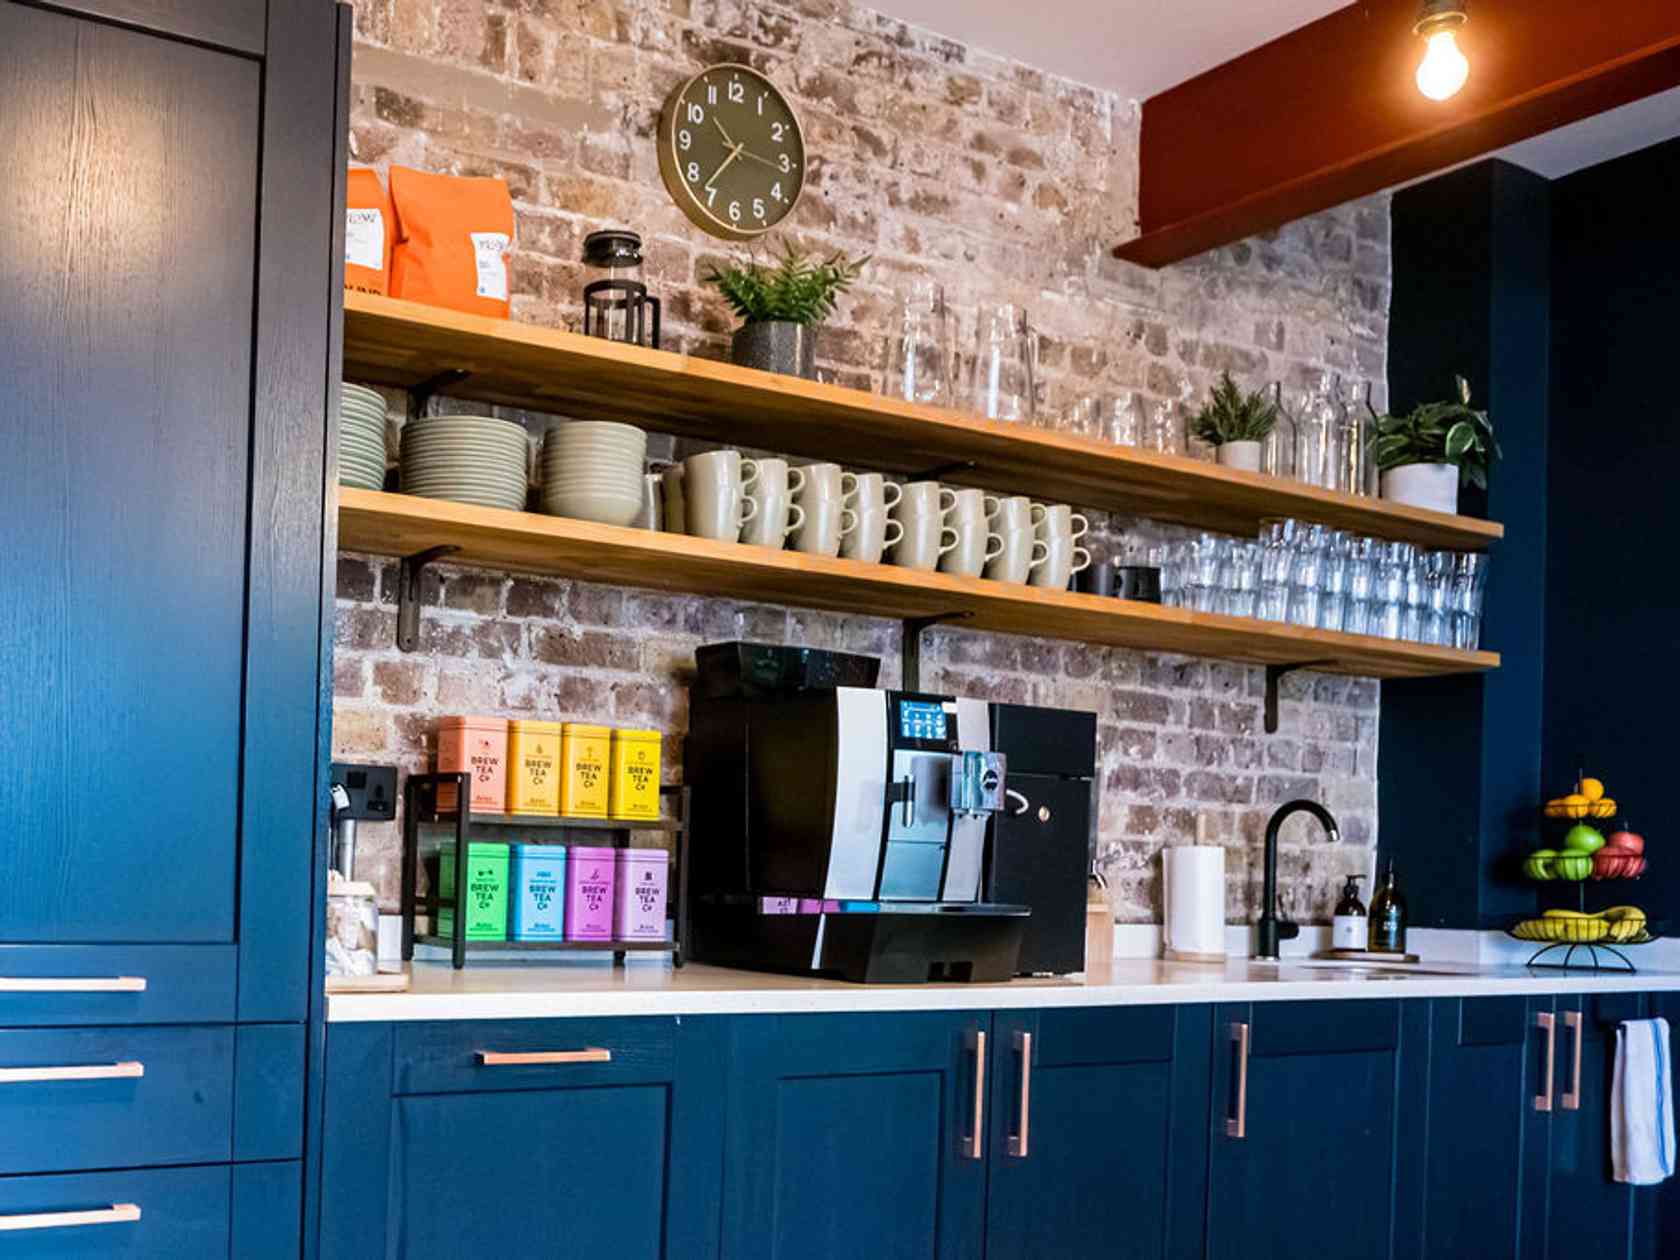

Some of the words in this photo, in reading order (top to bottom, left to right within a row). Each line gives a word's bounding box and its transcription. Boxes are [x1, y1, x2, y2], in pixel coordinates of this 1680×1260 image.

[708, 85, 718, 105] 11
[728, 81, 745, 104] 12
[757, 95, 763, 116] 1
[687, 102, 704, 124] 10
[771, 122, 784, 142] 2
[679, 129, 692, 150] 9
[778, 153, 790, 173] 3
[687, 162, 700, 182] 8
[770, 181, 782, 201] 4
[705, 186, 718, 207] 7
[728, 201, 741, 221] 6
[752, 198, 765, 218] 5
[471, 756, 499, 766] BREW
[525, 759, 552, 768] BREW
[476, 765, 493, 774] TEA
[530, 768, 546, 776] TEA
[576, 763, 601, 772] BREW
[627, 766, 654, 775] BREW
[580, 771, 598, 780] TEA
[632, 774, 649, 783] TEA
[470, 883, 499, 892] BREW
[529, 885, 556, 893] BREW
[582, 886, 607, 895] BREW
[635, 887, 660, 896] BREW
[476, 892, 493, 900] TEA
[534, 893, 551, 902] TEA
[586, 894, 602, 902] TEA
[640, 895, 655, 904] TEA
